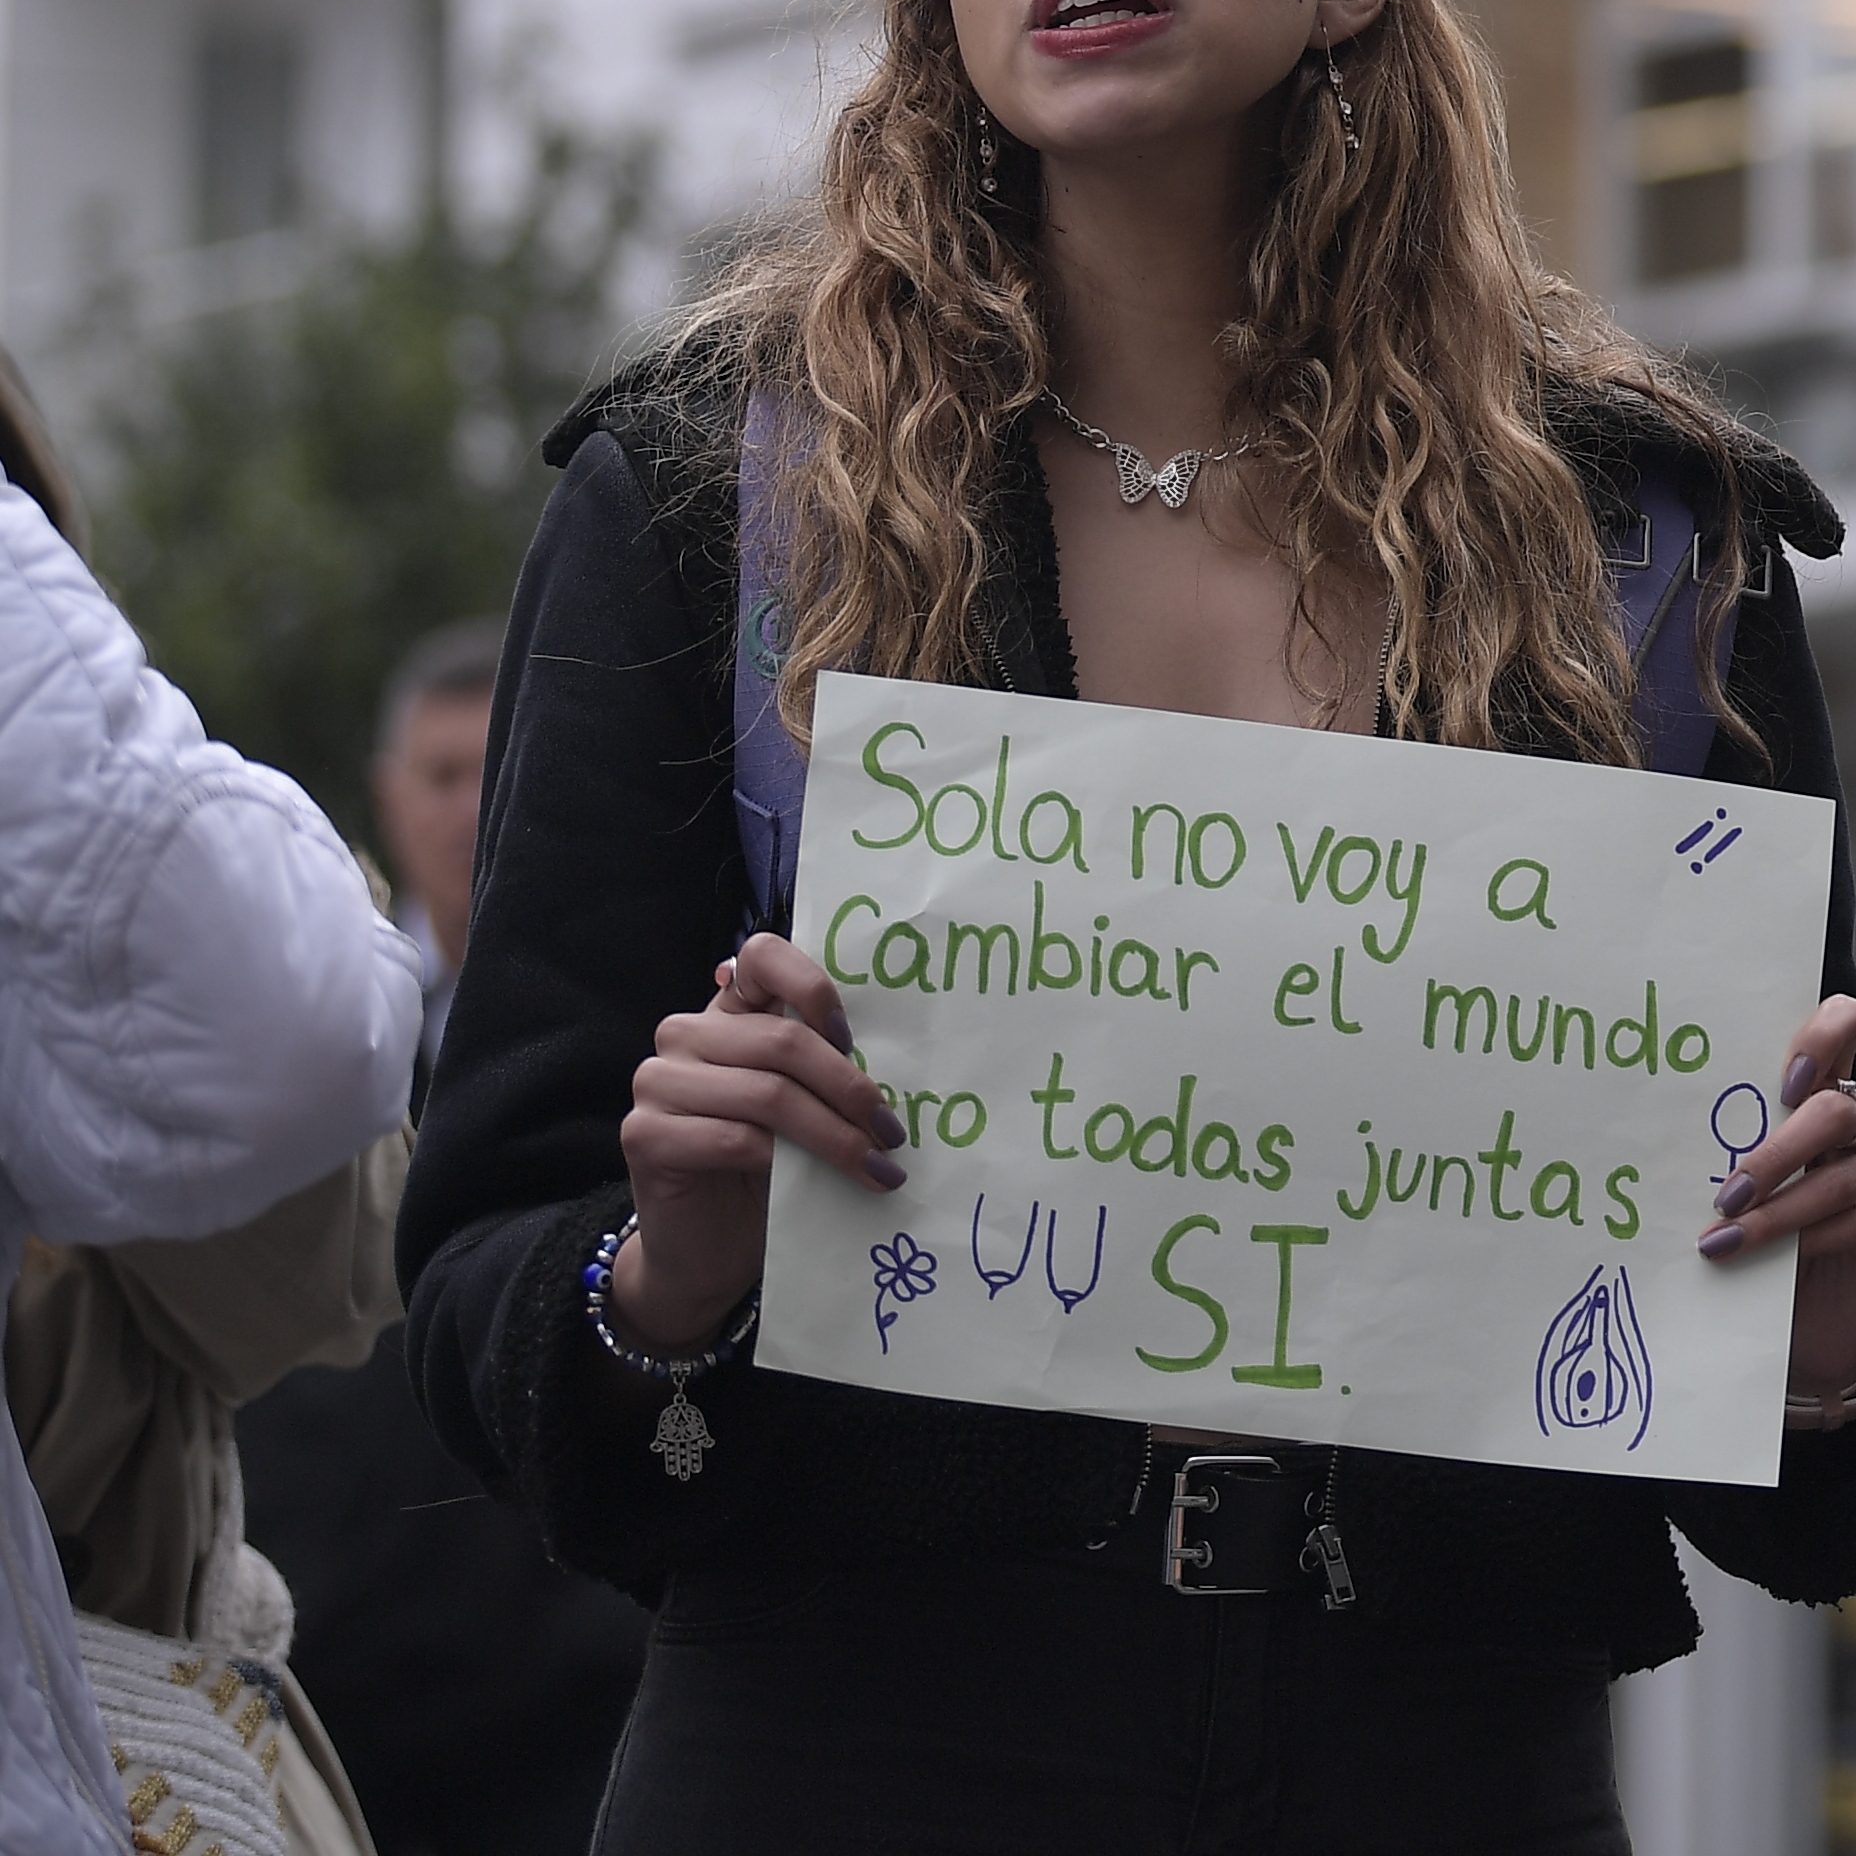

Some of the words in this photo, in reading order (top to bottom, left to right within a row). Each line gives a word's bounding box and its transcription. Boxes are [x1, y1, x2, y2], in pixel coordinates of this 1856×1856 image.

[850, 721, 1089, 875] Sola
[1131, 800, 1248, 891] no
[1276, 820, 1428, 966] voy
[1486, 856, 1557, 932] a
[821, 880, 1220, 1013] Cambiar
[1273, 945, 1362, 1036] el
[1422, 978, 1712, 1076] mundo
[1030, 1051, 1295, 1193] todas
[1334, 1108, 1644, 1242] juntas
